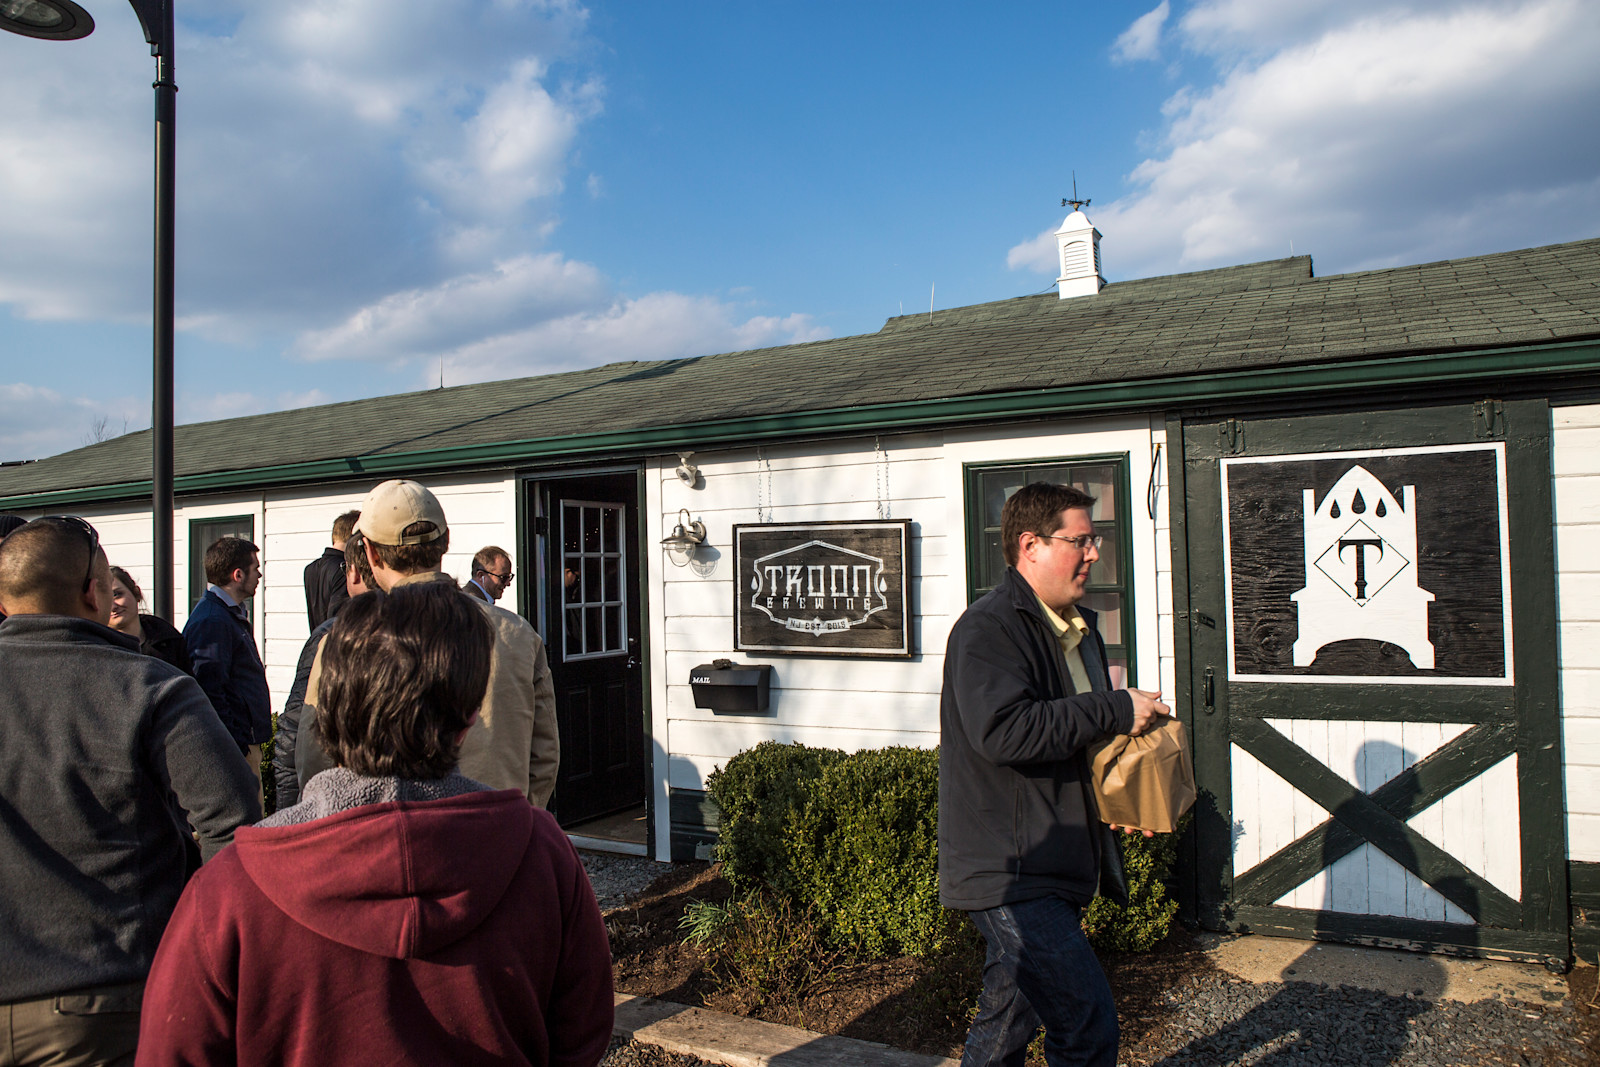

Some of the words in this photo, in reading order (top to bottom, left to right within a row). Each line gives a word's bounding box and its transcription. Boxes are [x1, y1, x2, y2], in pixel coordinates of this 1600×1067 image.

[1338, 538, 1384, 600] T
[764, 565, 872, 603] TROON
[766, 597, 872, 611] BREWING
[790, 619, 801, 629] NJ
[805, 622, 821, 631] EST
